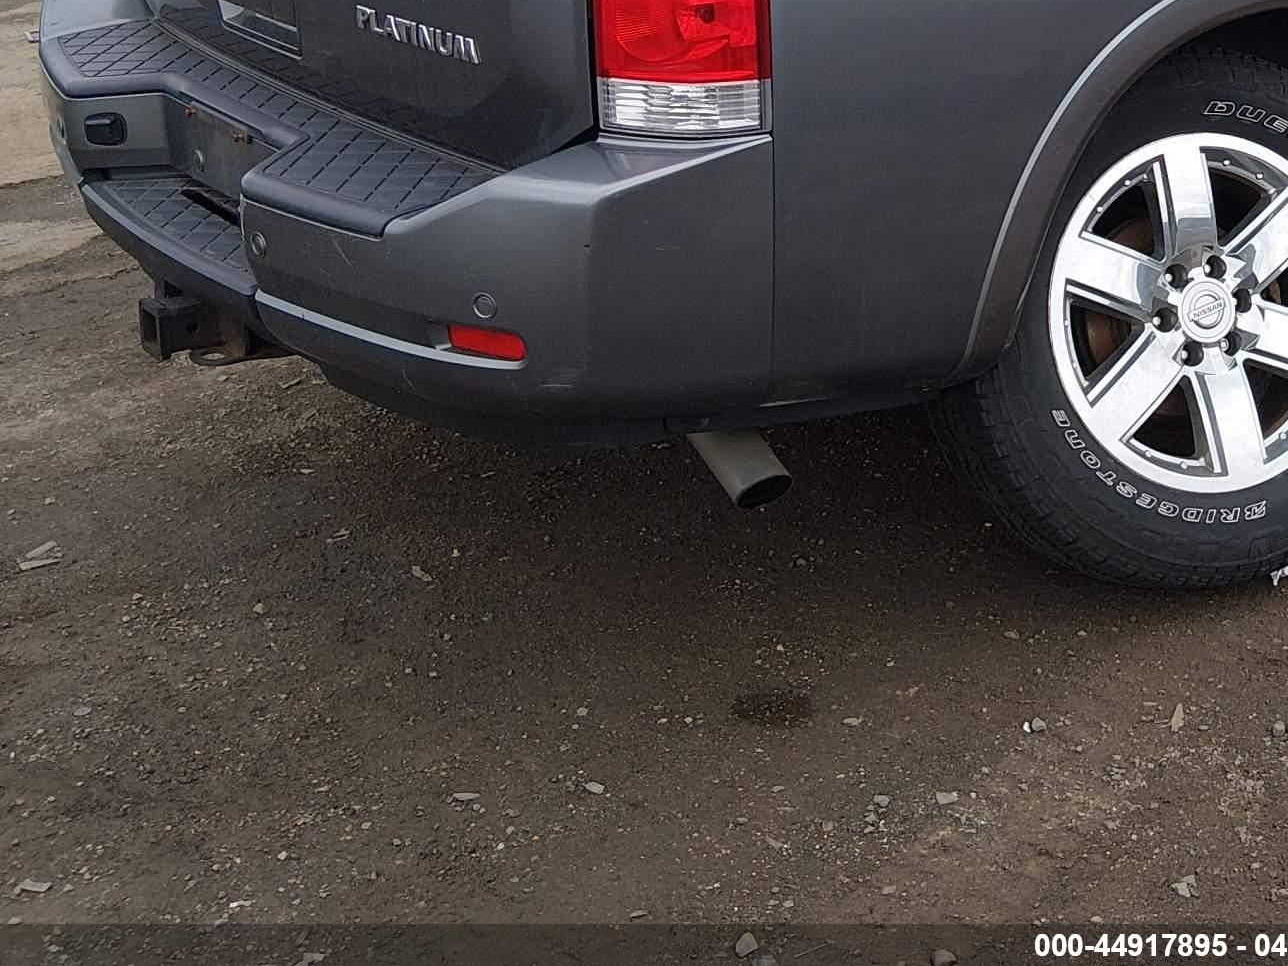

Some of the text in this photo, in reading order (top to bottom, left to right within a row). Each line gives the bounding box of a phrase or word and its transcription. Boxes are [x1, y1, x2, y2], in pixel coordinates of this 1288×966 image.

[356, 4, 481, 64] PLATINUM
[1193, 301, 1223, 320] NISSAN
[1051, 409, 1267, 524] BRIDGESTONE
